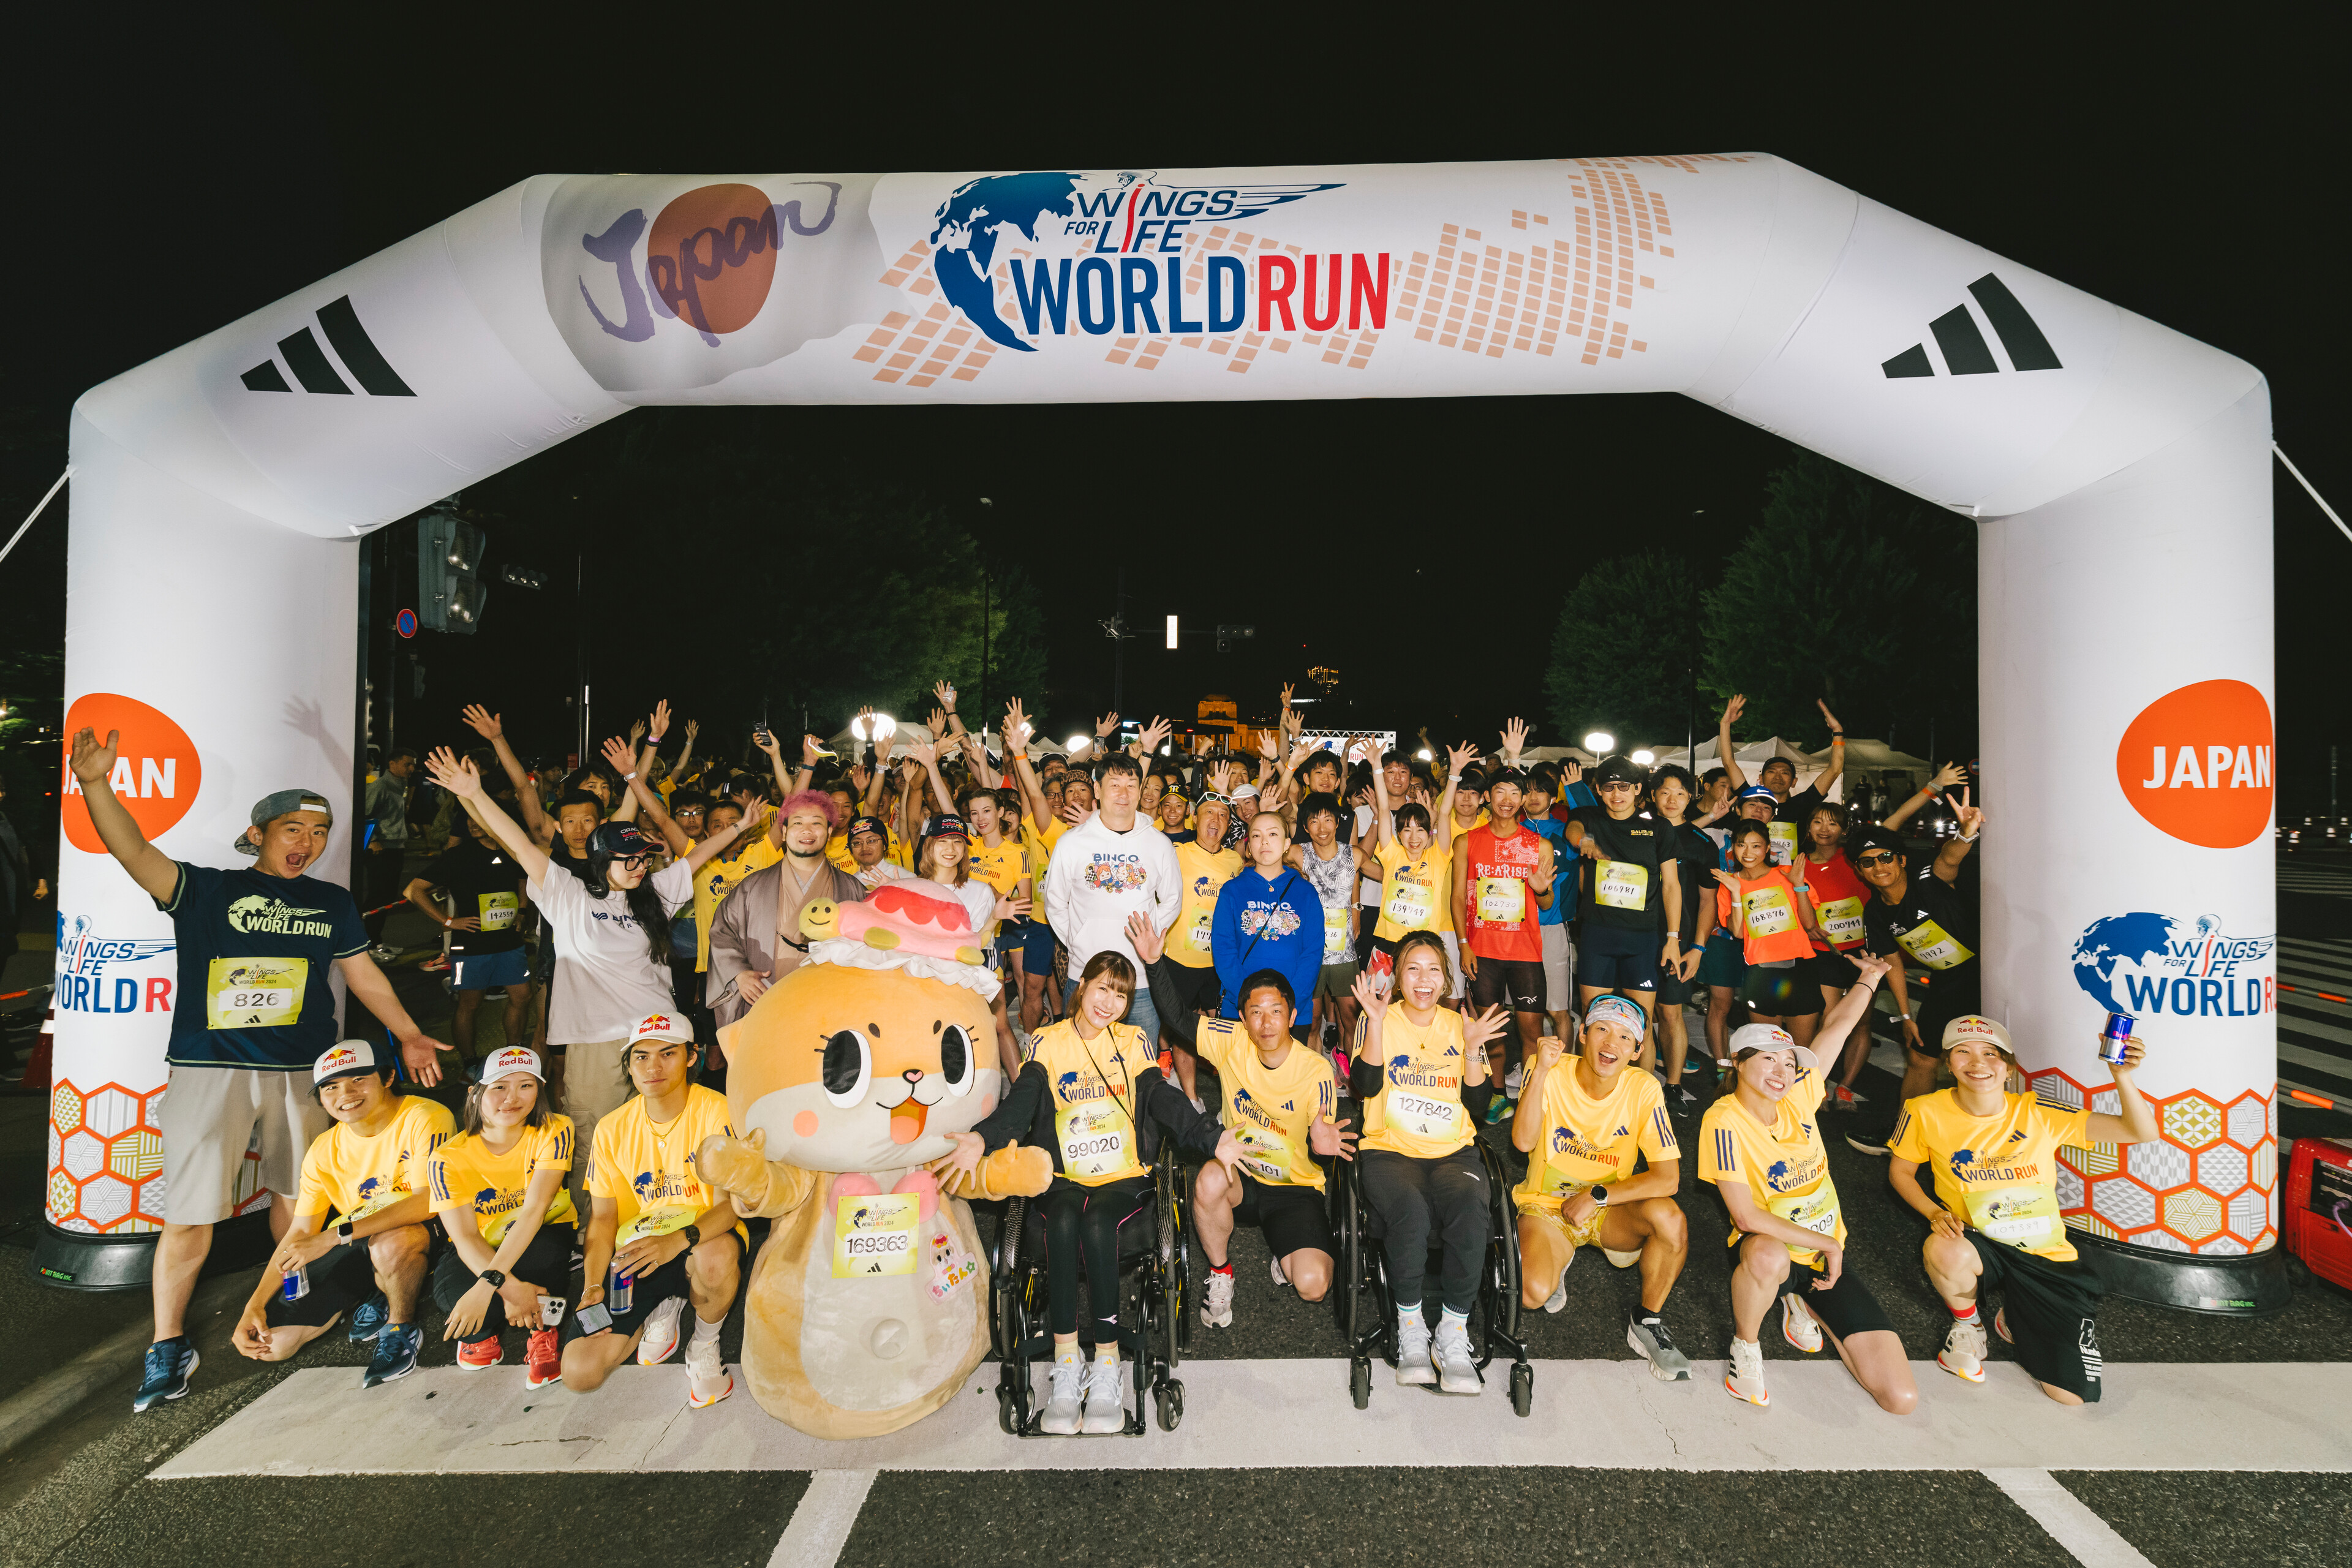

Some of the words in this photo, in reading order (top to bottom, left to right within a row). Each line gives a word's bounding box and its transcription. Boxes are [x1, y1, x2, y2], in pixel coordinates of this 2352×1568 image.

[1064, 221, 1099, 236] FOR
[1096, 219, 1191, 254] LIFE
[2143, 745, 2271, 789] JAPAN
[841, 859, 854, 869] RUN
[987, 870, 1001, 880] RUN
[1421, 879, 1433, 888] RUN
[717, 886, 733, 895] WOR
[1201, 888, 1219, 898] WORL
[1752, 910, 1784, 924] 168876
[67, 957, 108, 976] LIFE
[2163, 959, 2187, 967] FOR
[2184, 960, 2240, 978] LIFE
[234, 992, 279, 1008] 826
[2125, 973, 2261, 1017] WORLD
[639, 1024, 654, 1035] Red
[1977, 1027, 1993, 1035] Bull
[322, 1060, 337, 1073] Red
[338, 1056, 356, 1066] Bull
[499, 1057, 516, 1067] Red
[1399, 1072, 1436, 1087] WORLD
[1437, 1076, 1458, 1088] RUN
[1068, 1085, 1105, 1101] WORLD
[1399, 1096, 1452, 1121] 127842
[1242, 1103, 1270, 1128] WORLD
[1270, 1120, 1287, 1137] RUN
[1068, 1136, 1120, 1158] 99020
[1561, 1140, 1597, 1161] WORLD
[1597, 1154, 1620, 1168] RUN
[1781, 1169, 1816, 1190] WORLD
[1965, 1168, 2014, 1181] WORLD
[2014, 1163, 2039, 1180] RUN
[647, 1185, 682, 1200] WORLD
[682, 1183, 699, 1197] UN
[846, 1235, 908, 1253] 169363
